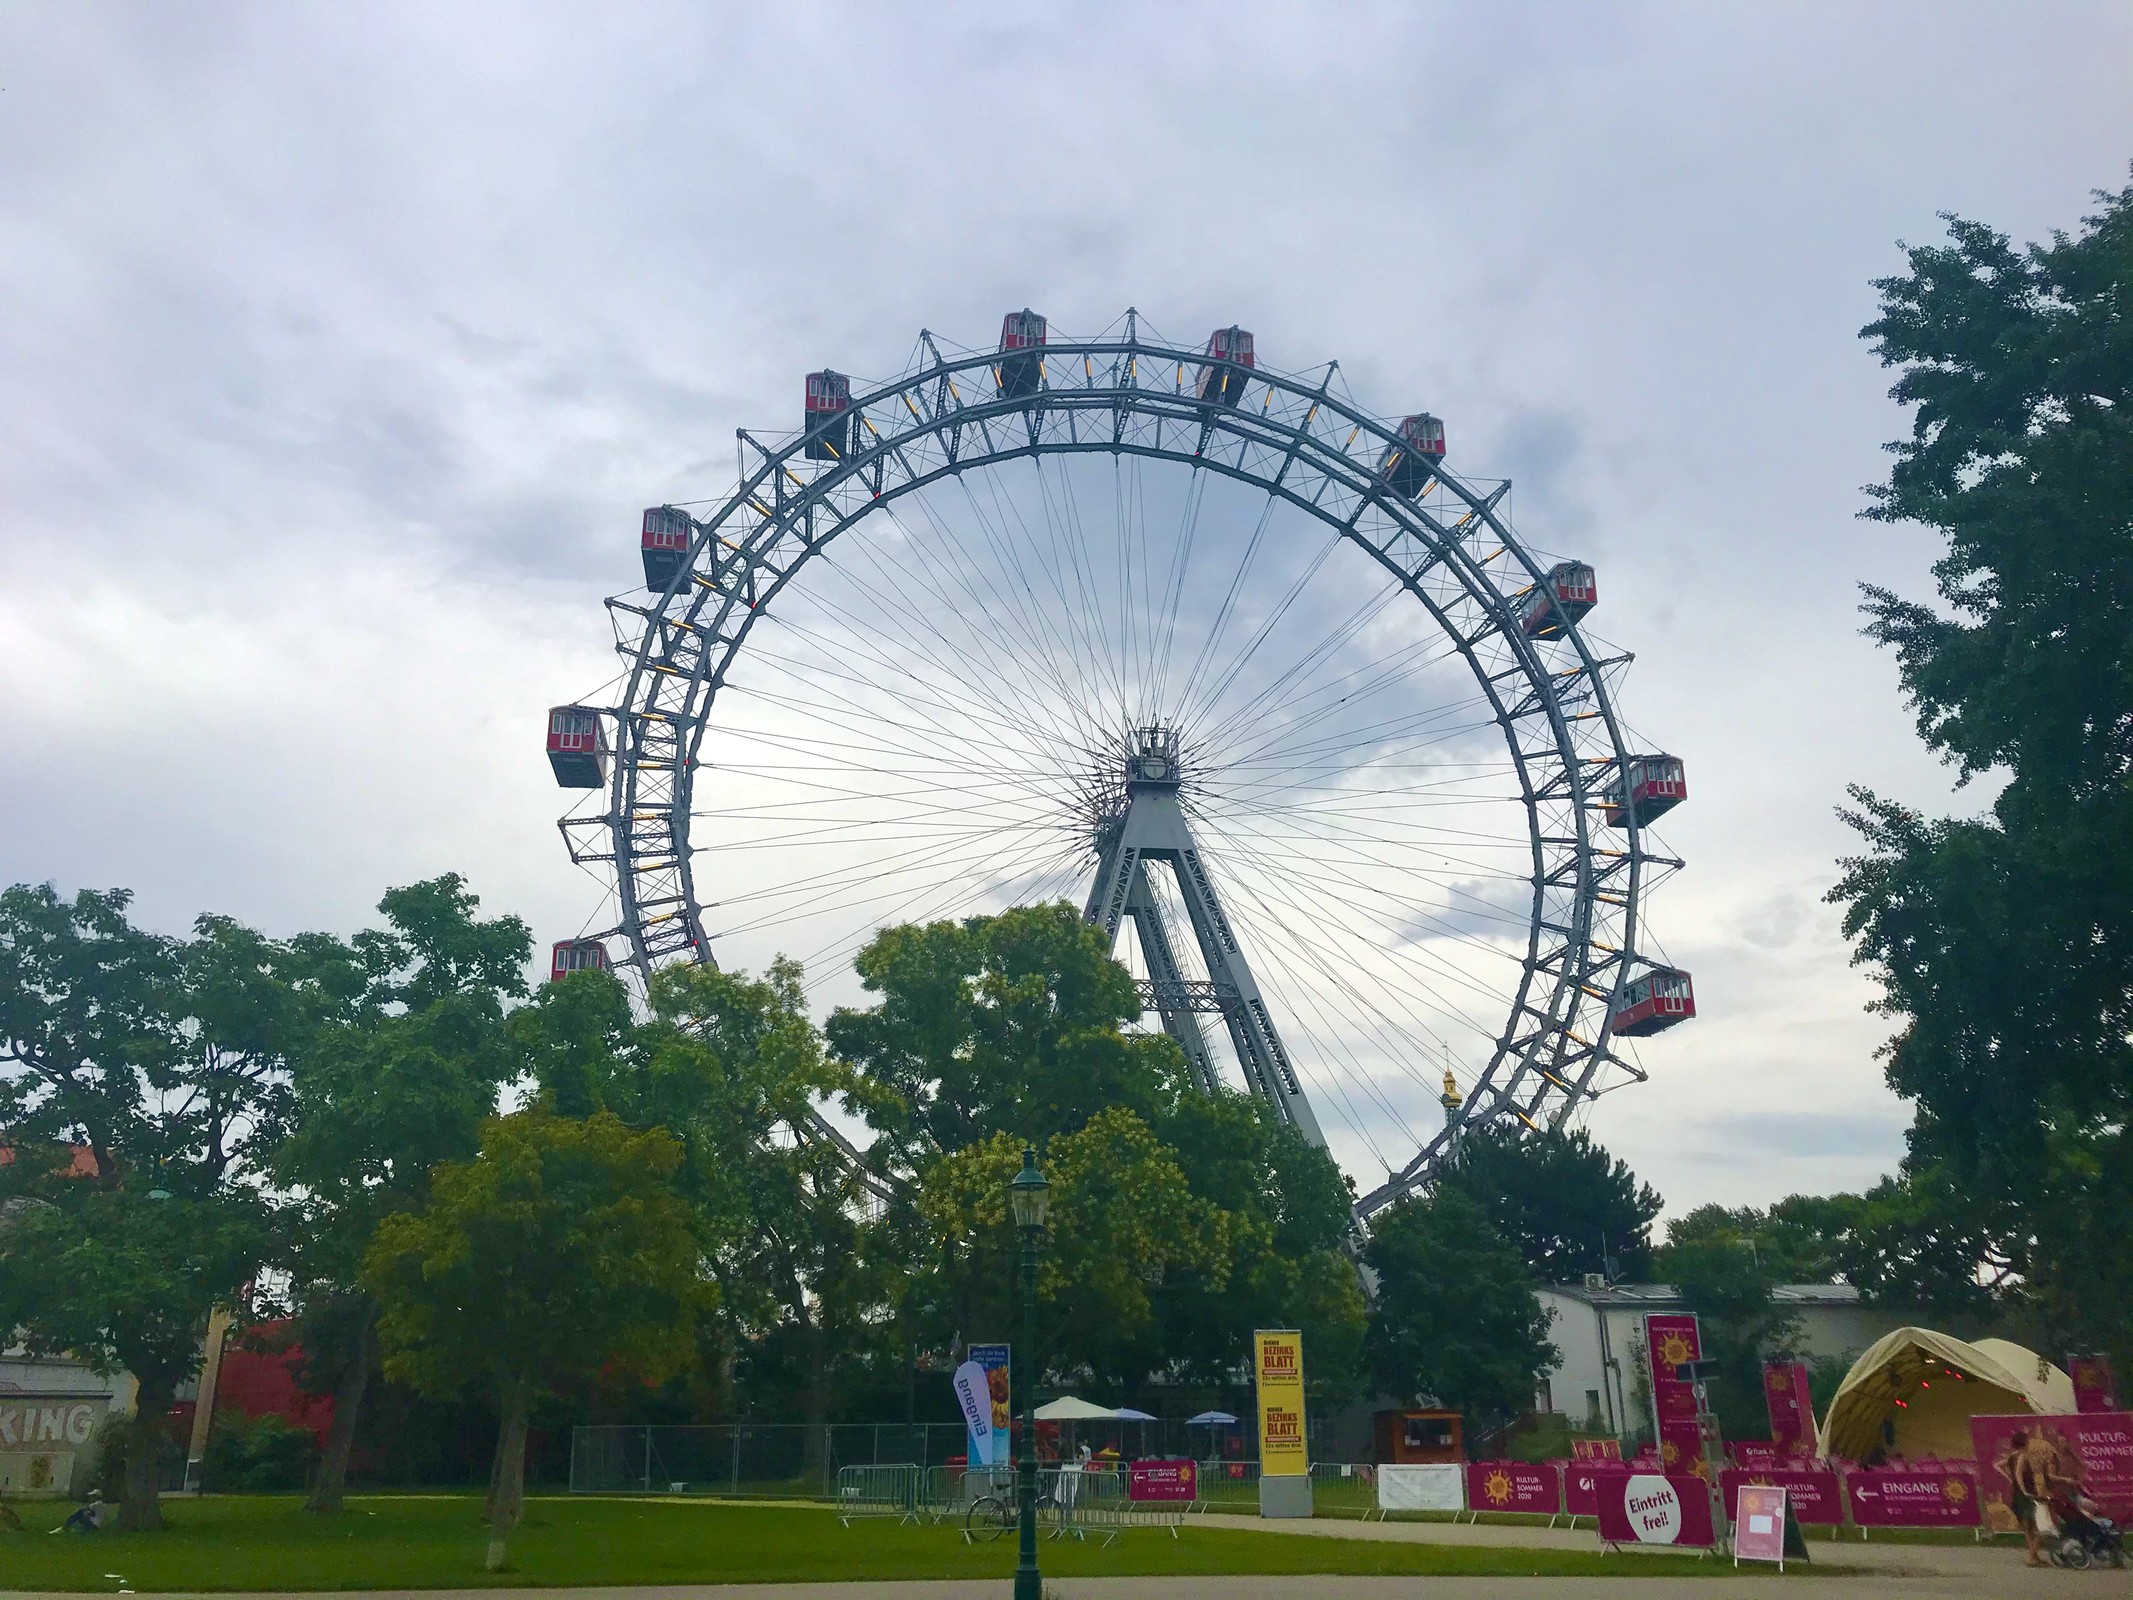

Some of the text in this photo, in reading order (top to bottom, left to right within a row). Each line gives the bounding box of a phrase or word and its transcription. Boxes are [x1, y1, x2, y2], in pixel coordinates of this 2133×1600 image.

[1263, 1346, 1294, 1355] BEZIRKS
[1264, 1355, 1294, 1368] BLATT
[1266, 1412, 1298, 1422] BEZIRKS
[1267, 1422, 1298, 1436] BLATT
[2079, 1431, 2131, 1443] KULTUR-
[1515, 1476, 1542, 1484] KULTUR-
[1516, 1484, 1544, 1492] SOMMER
[1785, 1483, 1818, 1492] KULTUR-
[1882, 1482, 1940, 1494] EINGANG
[1628, 1490, 1674, 1514] Eintritt
[1790, 1493, 1822, 1501] OMMER
[1642, 1511, 1669, 1532] frei!
